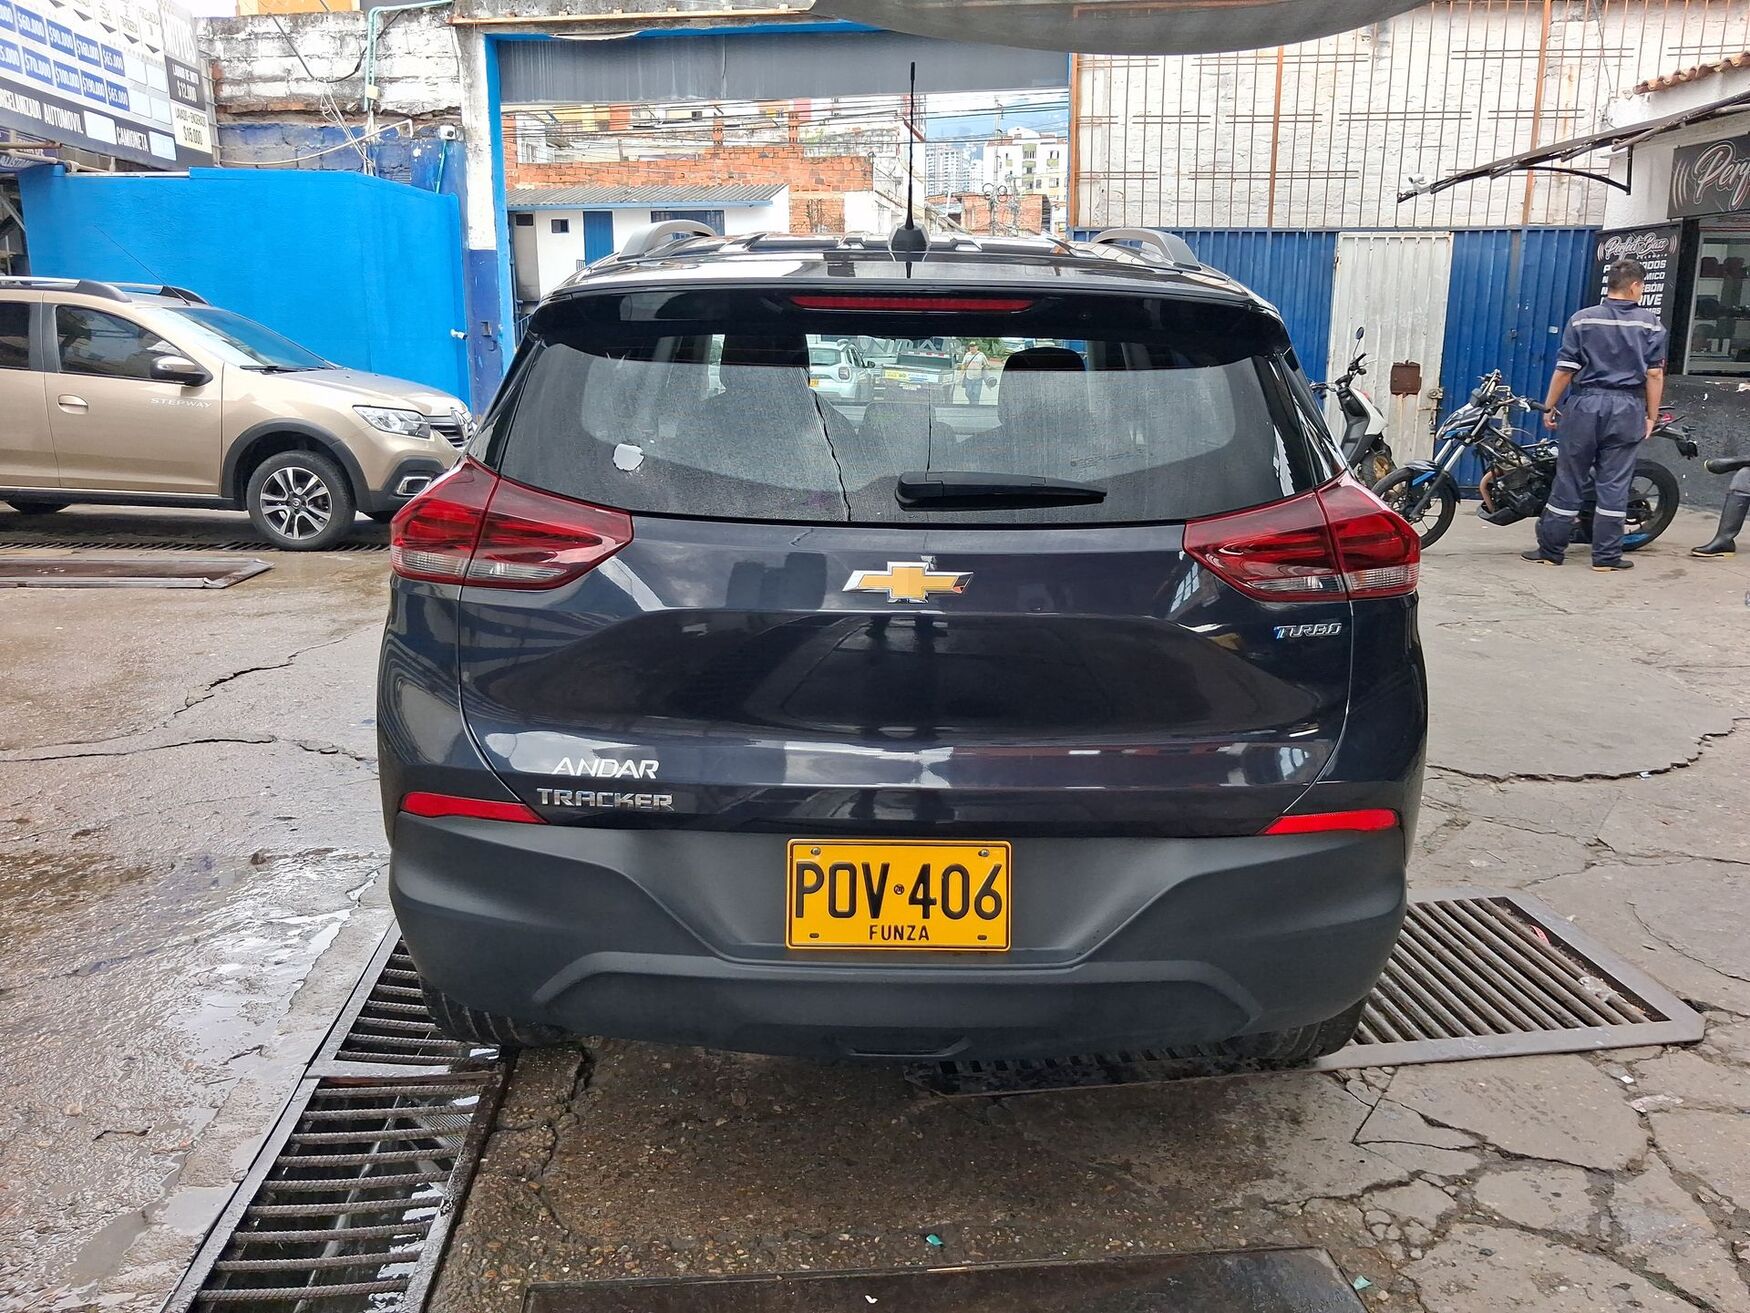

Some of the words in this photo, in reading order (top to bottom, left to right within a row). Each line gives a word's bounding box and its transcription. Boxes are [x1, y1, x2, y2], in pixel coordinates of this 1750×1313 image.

[151, 397, 212, 408] STEPWAY
[1273, 623, 1342, 639] TURBO
[551, 757, 660, 779] ANDAR
[536, 787, 675, 811] TRACKER
[869, 925, 929, 941] FUNZA
